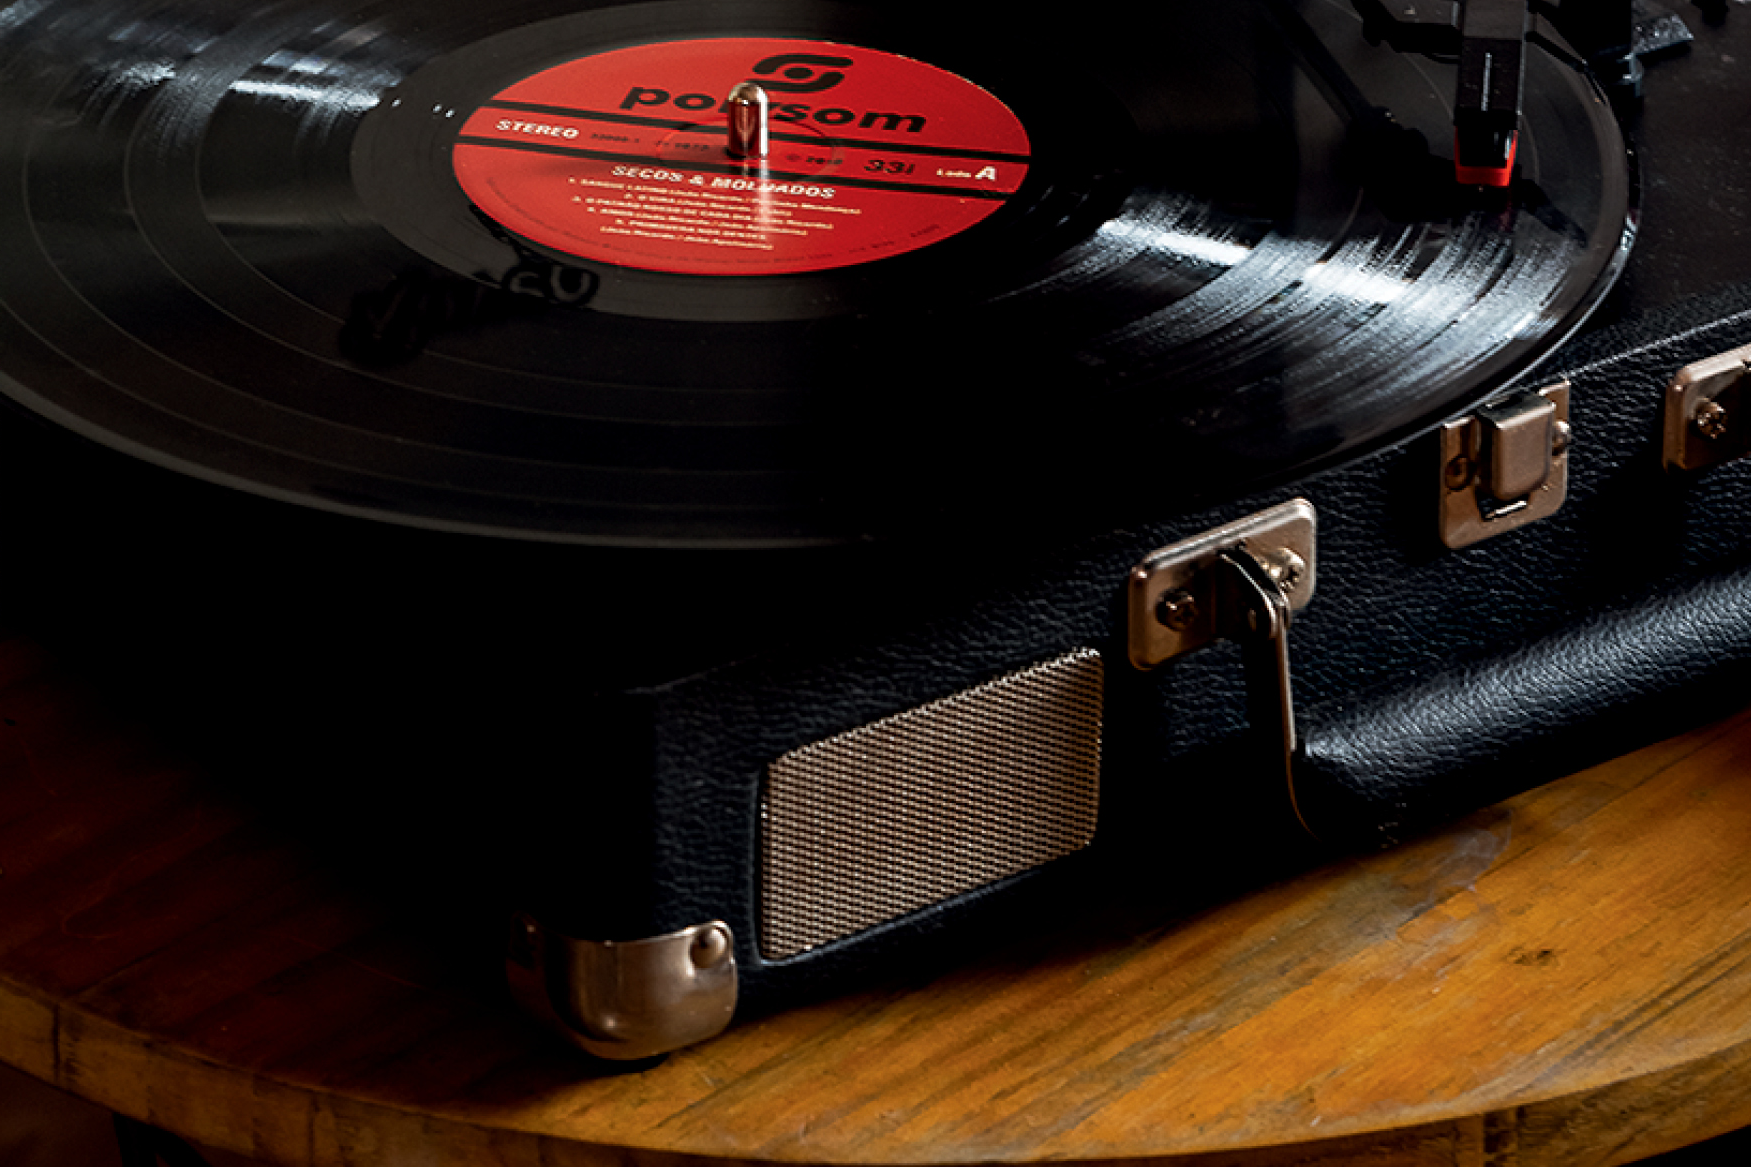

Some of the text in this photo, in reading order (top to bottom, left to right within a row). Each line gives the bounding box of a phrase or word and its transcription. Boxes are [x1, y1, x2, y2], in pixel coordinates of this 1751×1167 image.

[619, 86, 926, 134] posom
[496, 119, 580, 139] STEREO
[612, 166, 684, 183] SECOS
[688, 174, 704, 187] &
[975, 165, 996, 181] A
